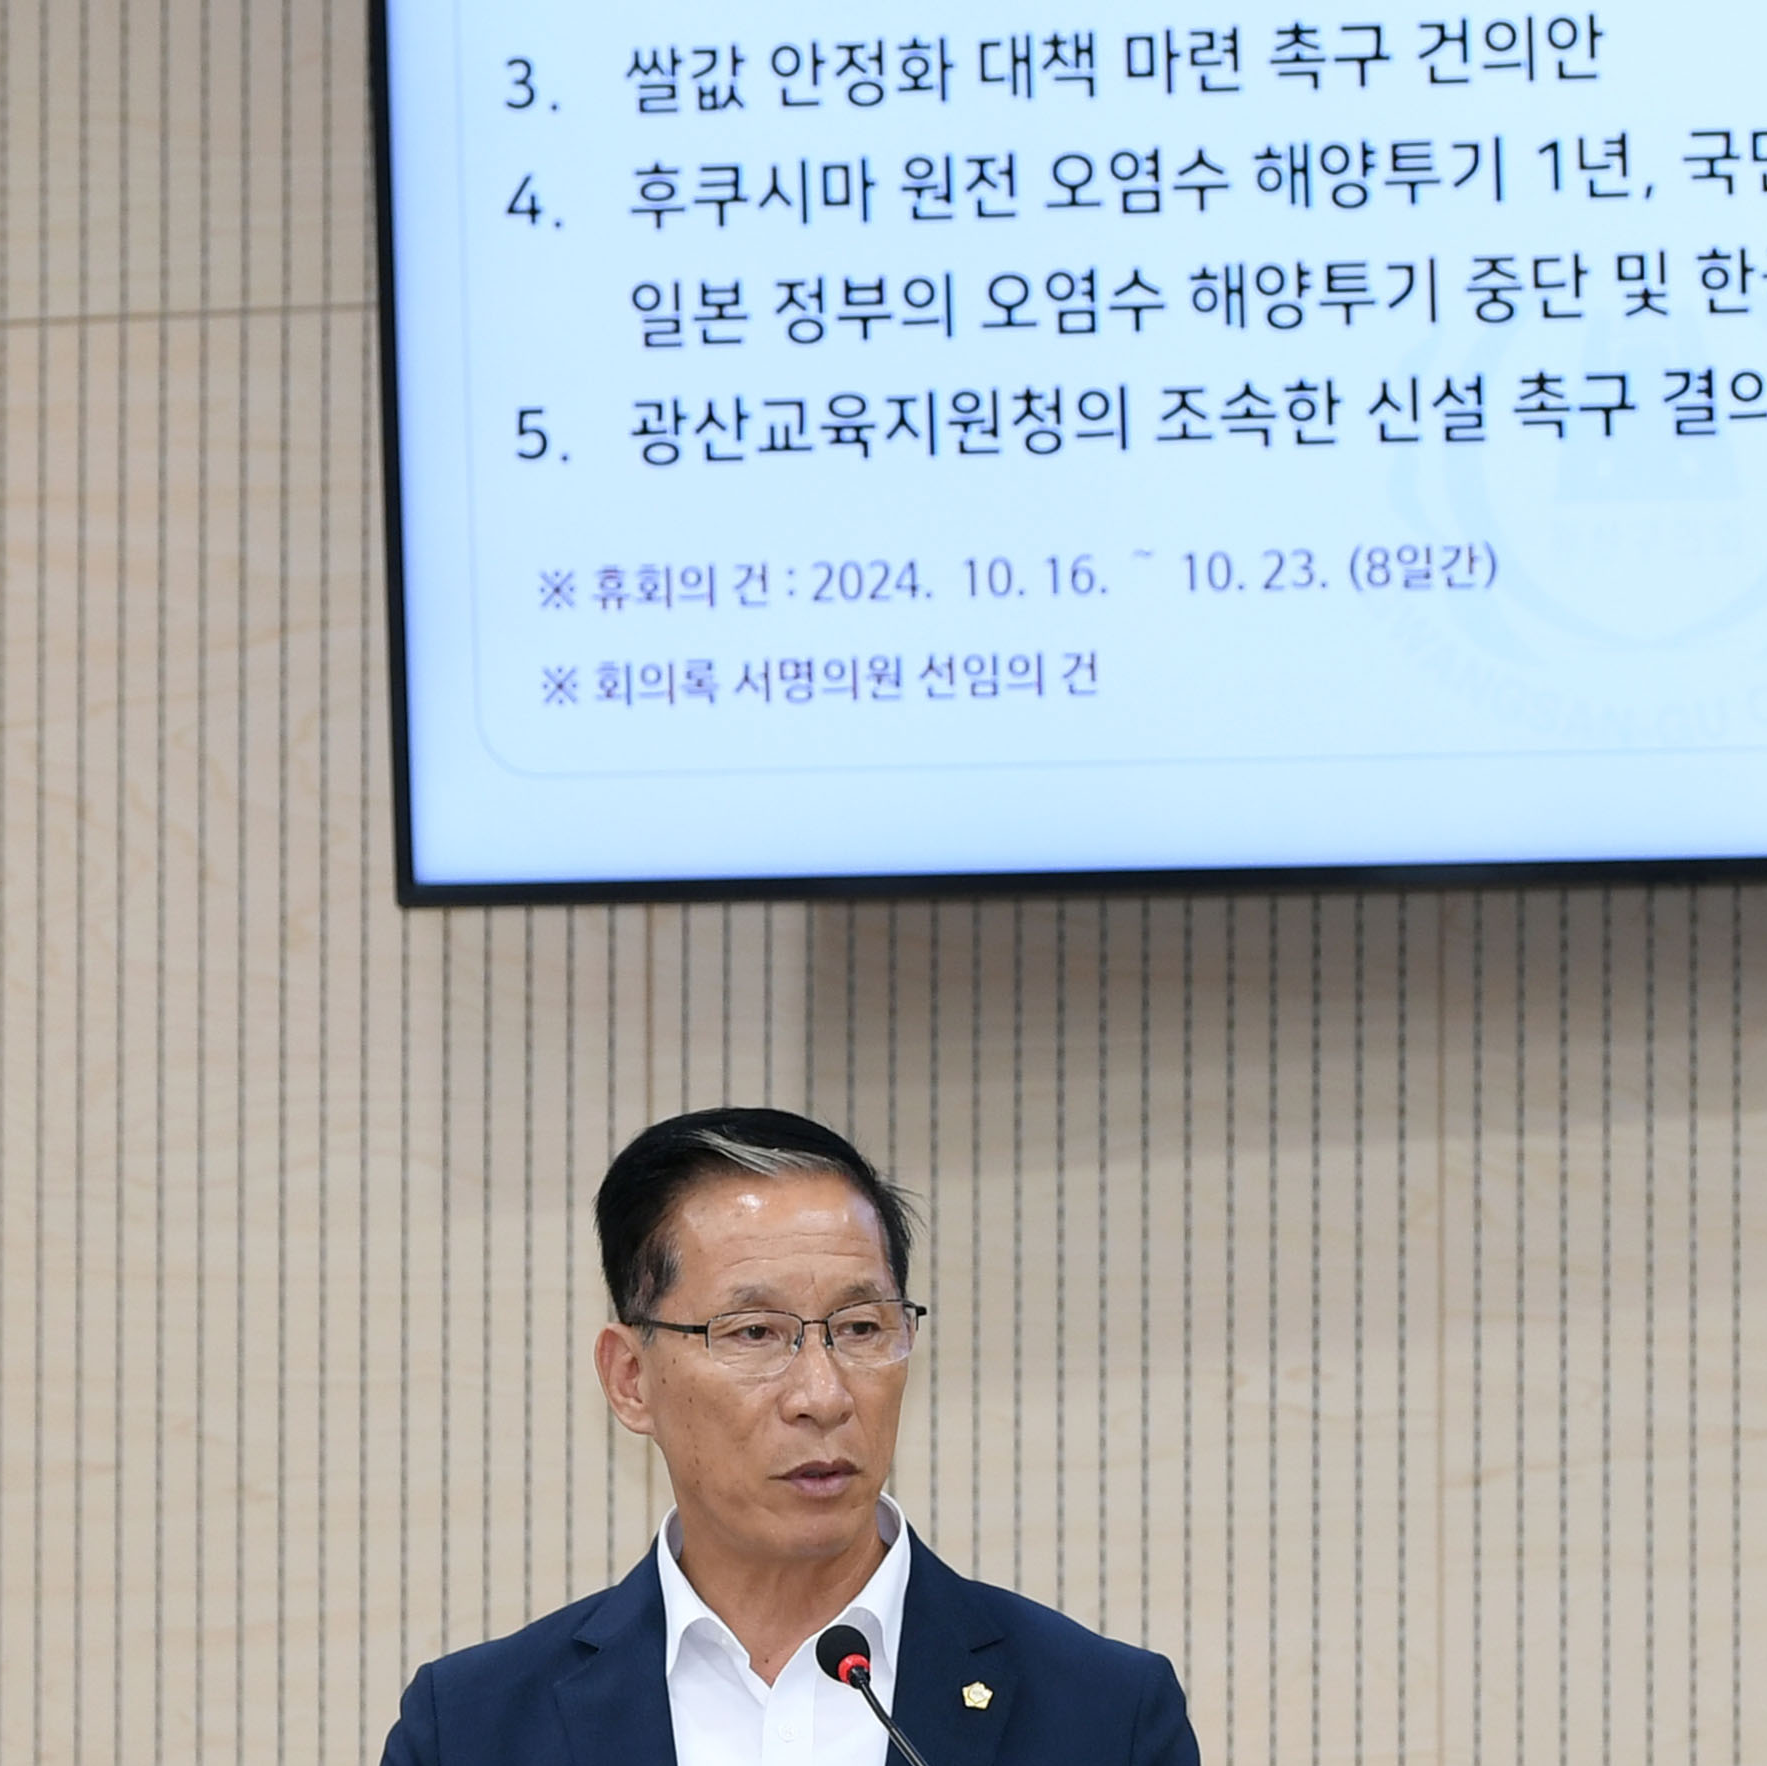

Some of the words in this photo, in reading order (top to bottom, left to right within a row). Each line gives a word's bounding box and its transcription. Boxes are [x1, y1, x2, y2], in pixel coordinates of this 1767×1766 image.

[504, 55, 561, 113] 3.
[625, 43, 746, 115] 쌀값
[770, 36, 955, 108] 안정화
[978, 30, 1097, 100] 대책
[1125, 25, 1241, 96] 마련
[1268, 21, 1392, 91] 촉구
[1417, 12, 1605, 86] 건의안
[504, 172, 564, 230] 4.
[629, 156, 877, 231] 후쿠시마
[900, 151, 1017, 222] 원전
[1045, 146, 1231, 215] 오염수
[1252, 134, 1504, 210] 해양투기
[1537, 130, 1655, 202] 1년,
[631, 279, 749, 349] 일본
[775, 271, 954, 345] 정부의
[981, 266, 1167, 336] 오염수
[1188, 255, 1438, 331] 해양투기
[1465, 251, 1590, 325] 중단
[1615, 249, 1669, 318] 및
[516, 406, 571, 464] 5.
[630, 383, 1130, 467] 광산교육지원청의
[1155, 377, 1342, 449] 조속한
[1367, 373, 1486, 444] 신설
[1512, 370, 1638, 441] 촉구
[593, 564, 717, 611] 휴회의
[733, 562, 769, 608] 건
[811, 559, 934, 603] 2024.
[1262, 548, 1330, 593] 23.
[1348, 540, 1500, 593] (8일간)
[595, 659, 719, 707] 회의록
[734, 655, 903, 704] 서명의원
[918, 652, 1045, 700] 선임의
[1061, 650, 1098, 697] 건
